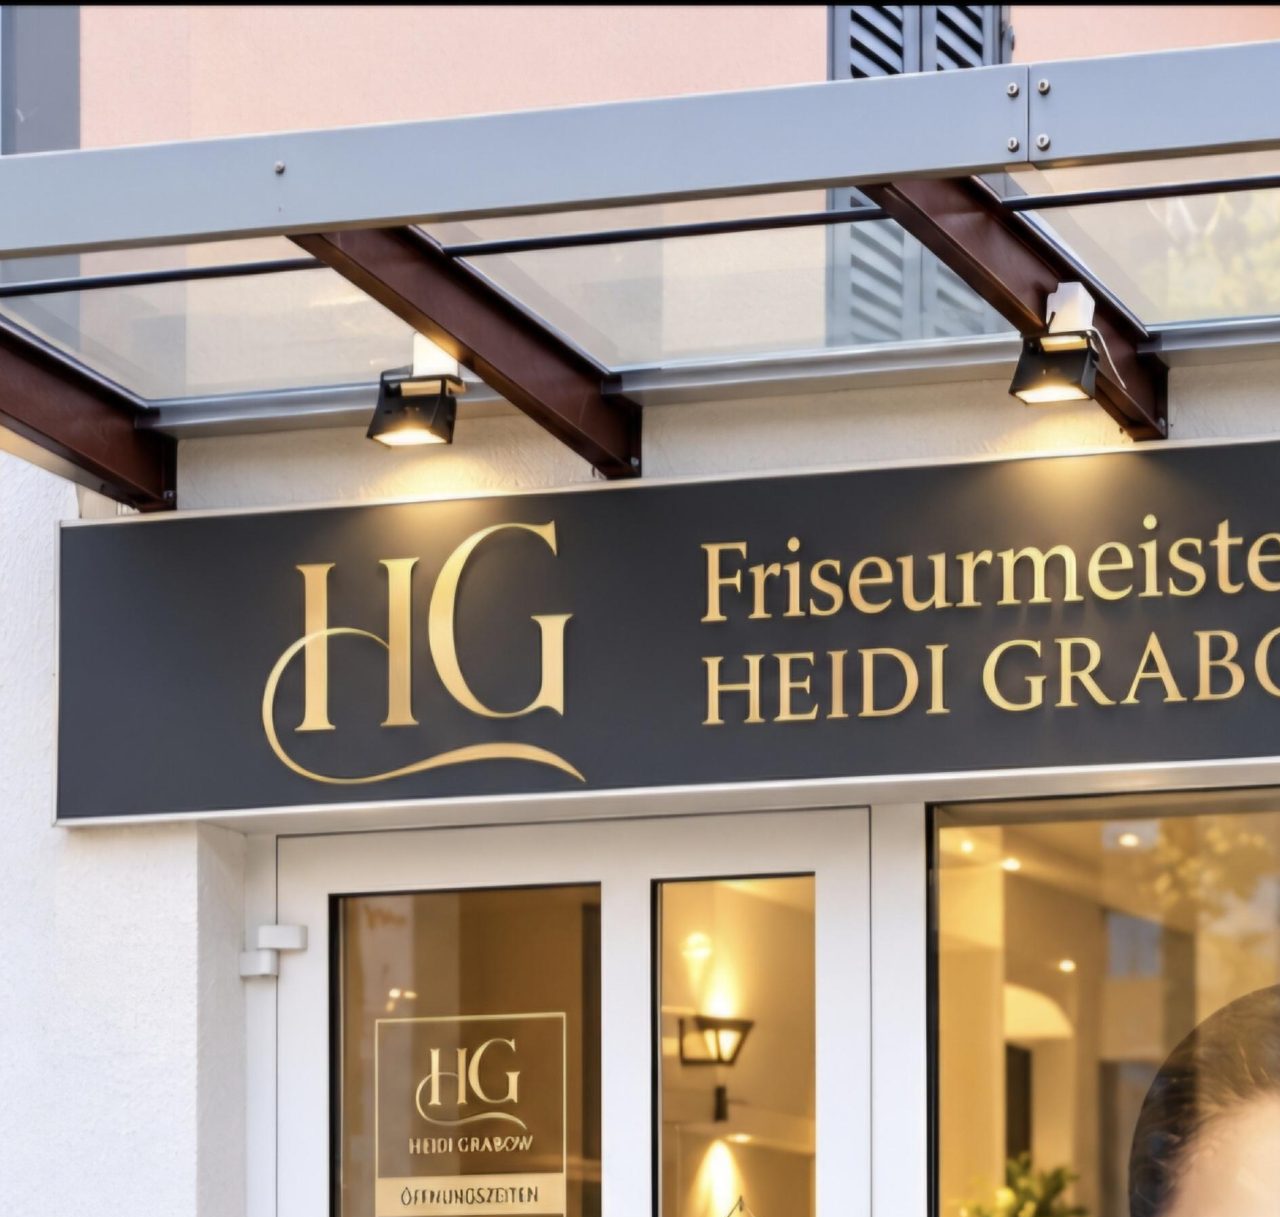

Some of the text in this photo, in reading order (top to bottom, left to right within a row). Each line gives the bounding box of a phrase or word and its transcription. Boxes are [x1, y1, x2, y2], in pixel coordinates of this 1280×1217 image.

[262, 520, 586, 785] HG
[702, 643, 951, 725] HEIDI
[415, 1037, 528, 1130] HG
[408, 1135, 534, 1154] HEIDI GRABOW
